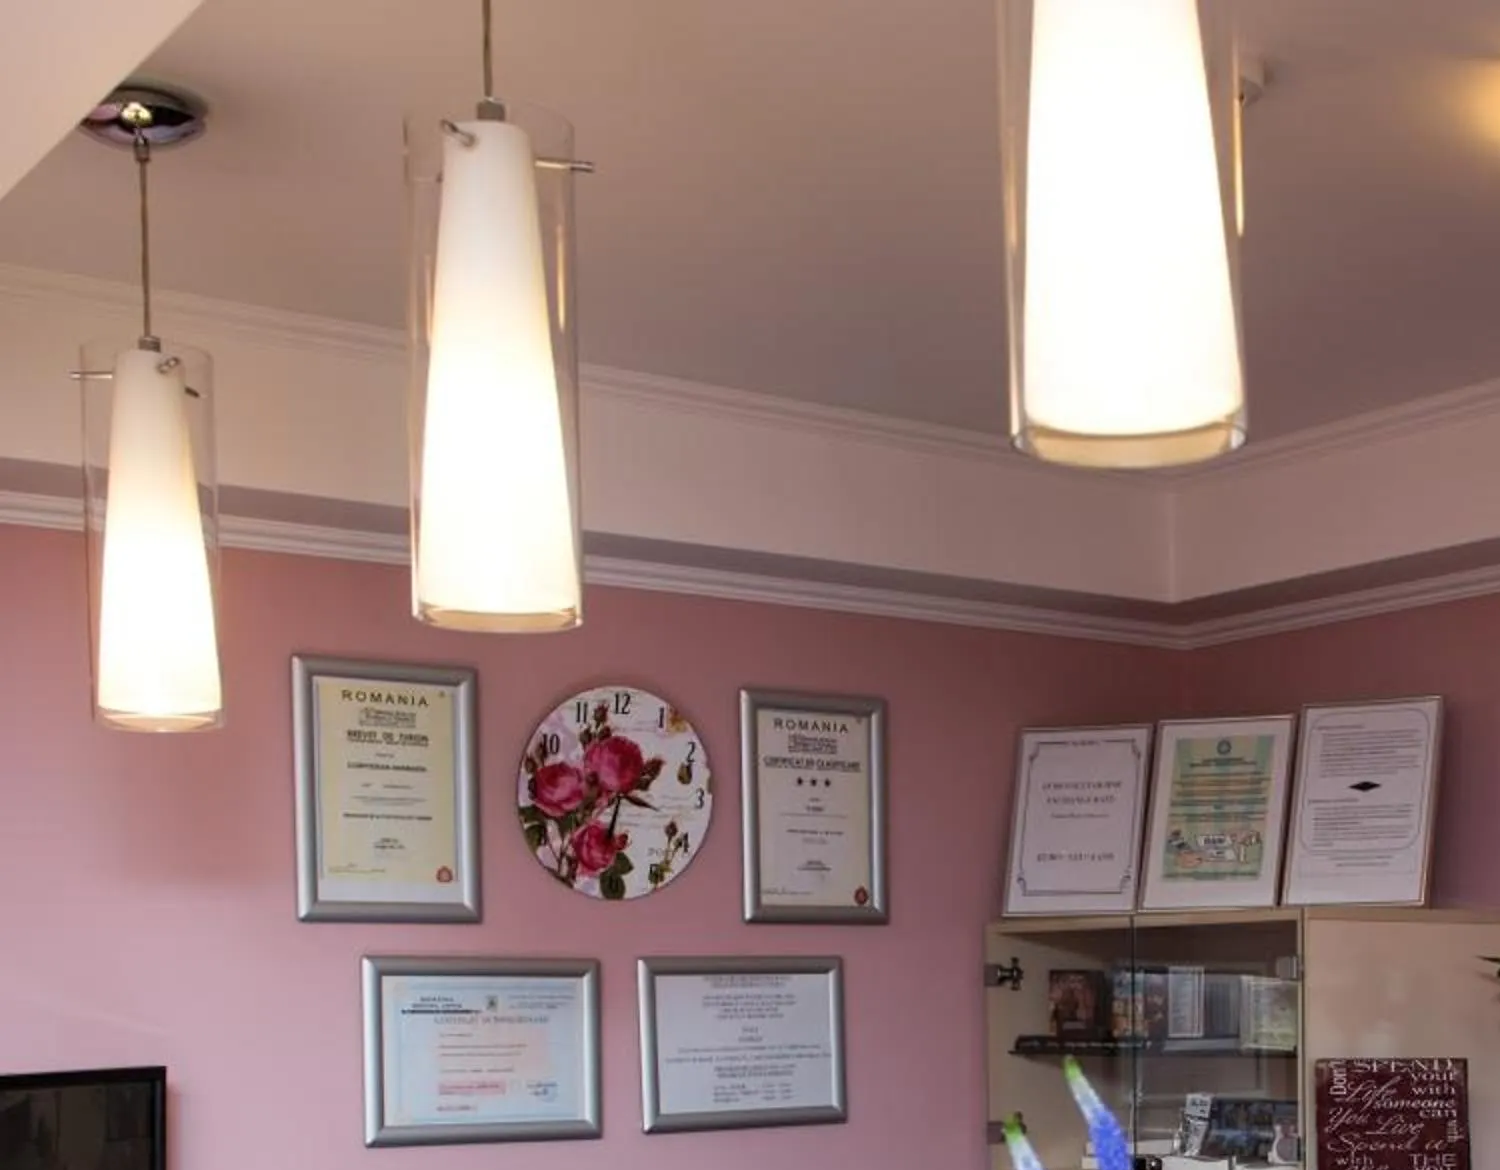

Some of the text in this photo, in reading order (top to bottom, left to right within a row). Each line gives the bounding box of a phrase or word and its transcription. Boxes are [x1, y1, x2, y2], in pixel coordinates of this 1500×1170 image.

[341, 689, 429, 707] ROMANIA
[613, 693, 632, 715] 12
[576, 702, 588, 723] 11
[658, 707, 665, 728] 1
[773, 718, 849, 733] ROMANIA
[542, 734, 561, 754] 10
[686, 742, 696, 763] 2
[694, 788, 705, 809] 3
[1411, 1083, 1456, 1096] with
[1409, 1153, 1457, 1167] THE
